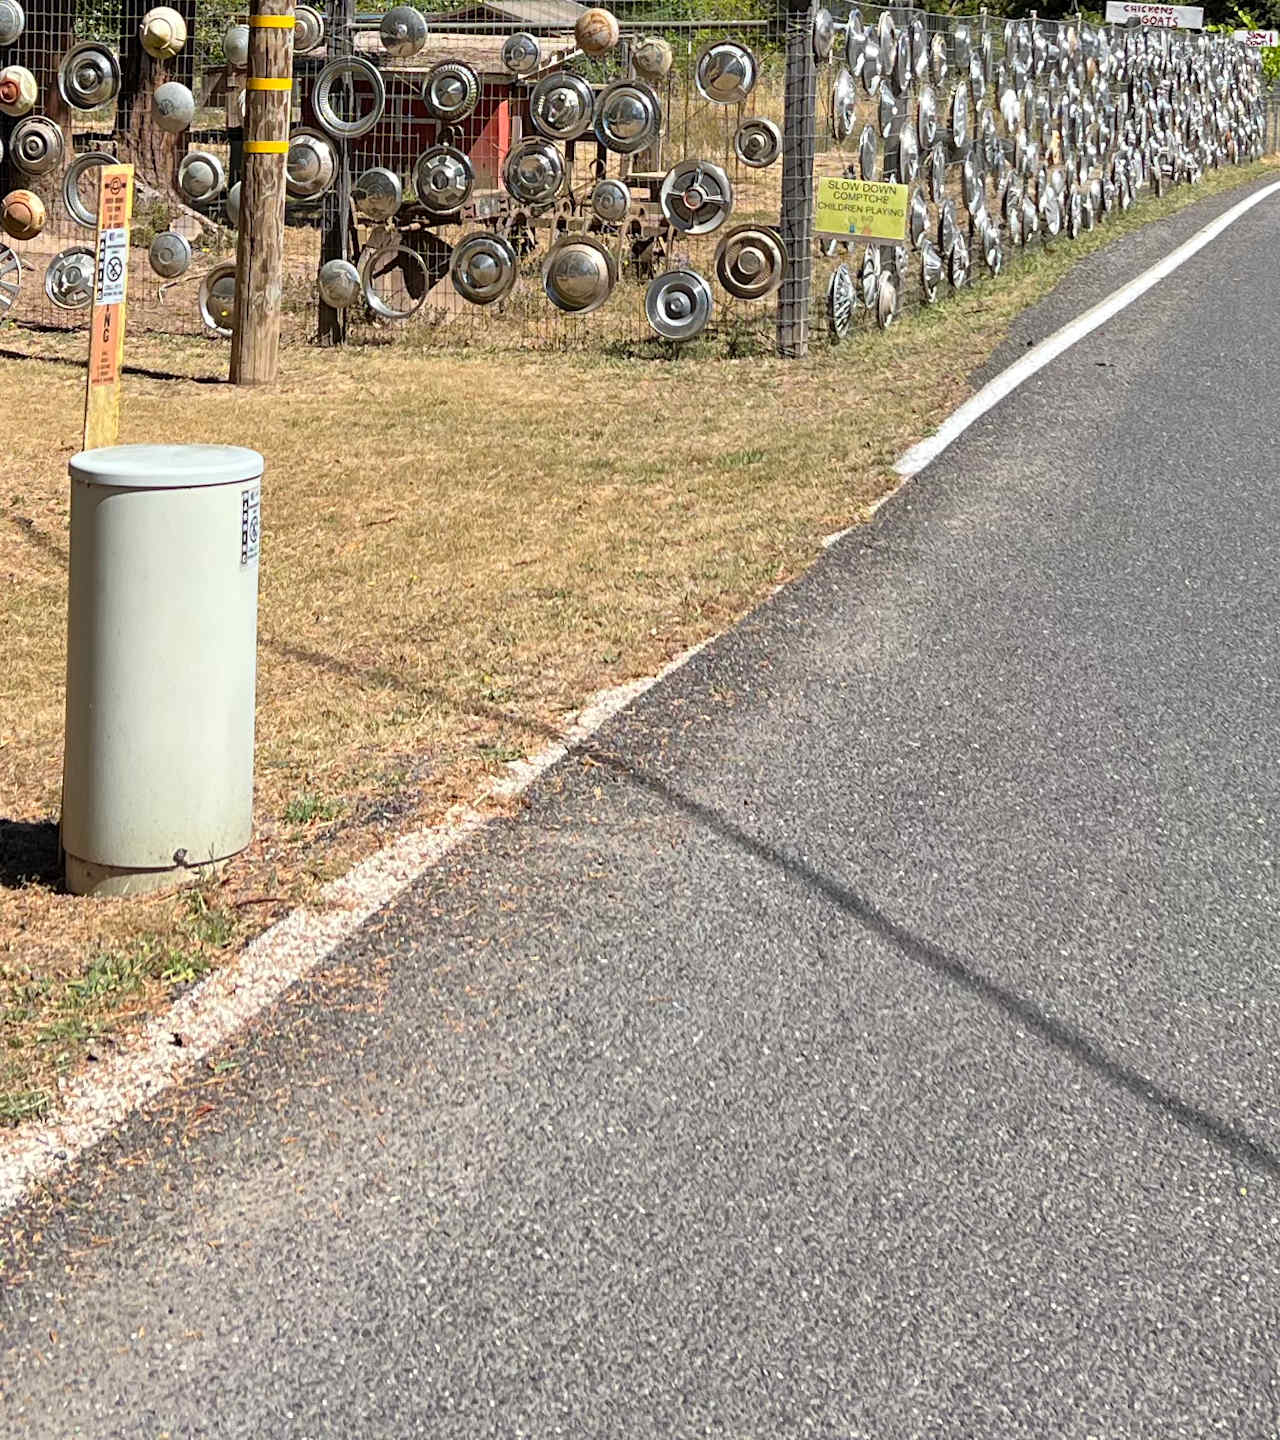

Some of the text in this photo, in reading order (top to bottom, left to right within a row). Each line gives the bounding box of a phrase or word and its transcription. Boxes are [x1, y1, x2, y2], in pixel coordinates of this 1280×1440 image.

[1141, 15, 1179, 27] GOATS
[828, 181, 897, 194] SLOW DOWN
[818, 201, 904, 217] CHILDREN PLAYING
